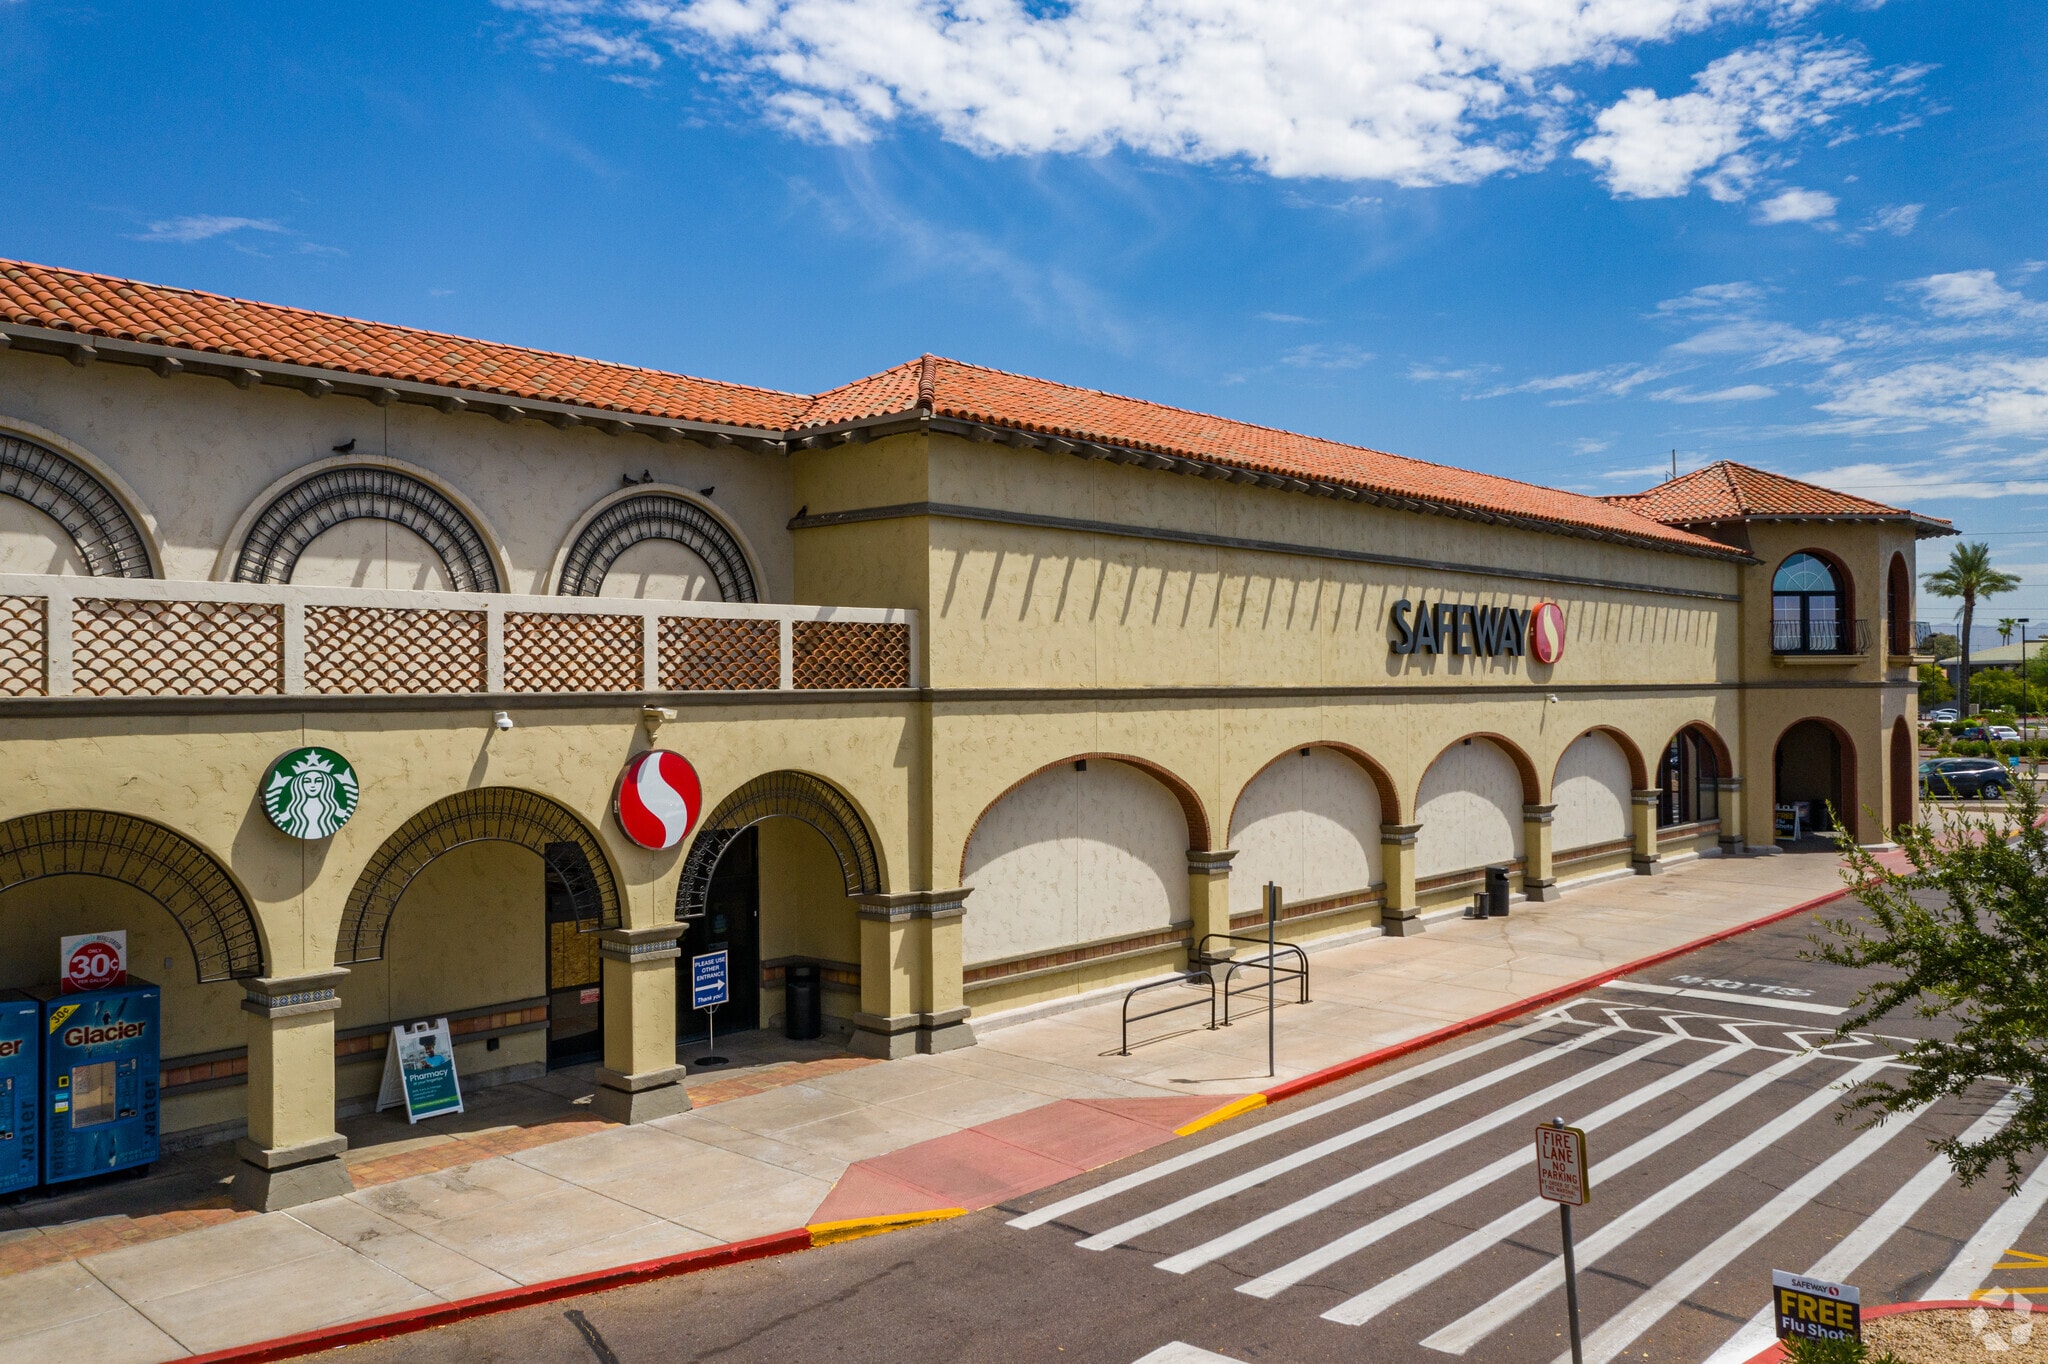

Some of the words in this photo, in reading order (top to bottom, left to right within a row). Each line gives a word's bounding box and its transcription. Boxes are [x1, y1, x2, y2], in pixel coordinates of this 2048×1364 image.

[1391, 599, 1531, 657] SAFEWAY
[695, 959, 714, 967] PLEASE
[701, 965, 720, 973] OTHER
[696, 971, 725, 981] ENTRANCE
[697, 995, 712, 1003] Thank
[63, 1020, 147, 1048] Glacier
[409, 1068, 449, 1082] Pharmacy
[143, 1080, 156, 1137] water
[20, 1101, 35, 1162] water
[1543, 1131, 1571, 1149] FIRE
[1542, 1145, 1574, 1164] LANE
[1552, 1161, 1566, 1172] NO
[1542, 1168, 1578, 1185] PARKING
[1791, 1278, 1828, 1293] SAFEWAY
[1780, 1289, 1854, 1330] FREE
[1782, 1316, 1805, 1334] Flu
